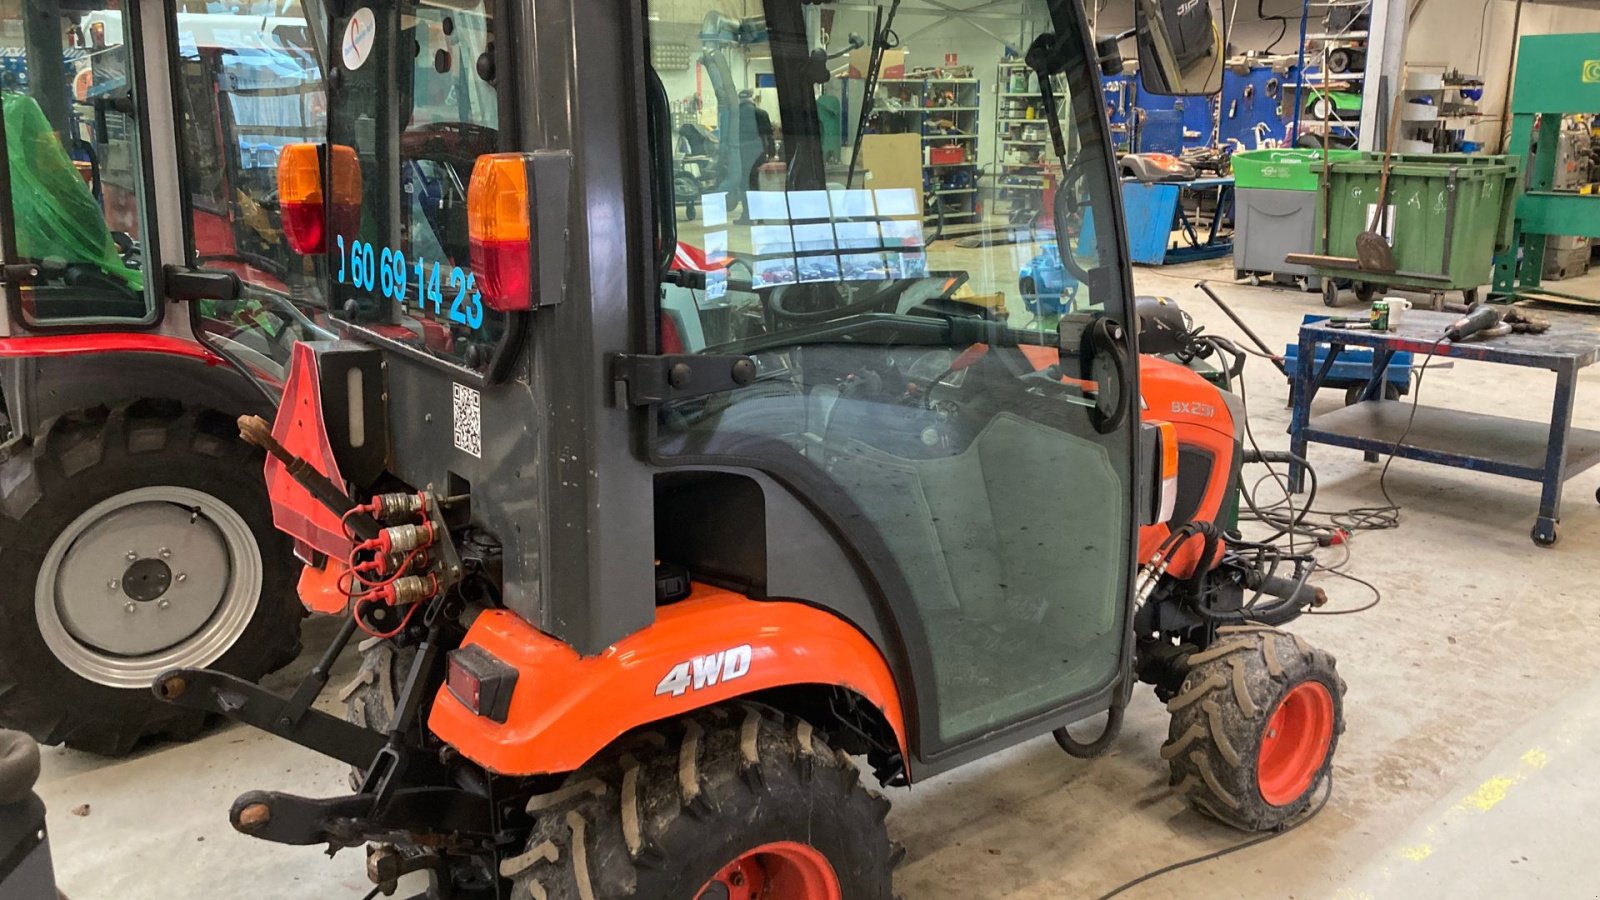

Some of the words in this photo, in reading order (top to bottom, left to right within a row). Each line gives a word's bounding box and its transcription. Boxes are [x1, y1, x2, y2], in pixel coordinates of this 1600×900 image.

[351, 239, 375, 292] 60
[380, 246, 407, 302] 69
[414, 257, 443, 315] 14
[449, 266, 484, 330] 23
[655, 643, 752, 697] 4WD
